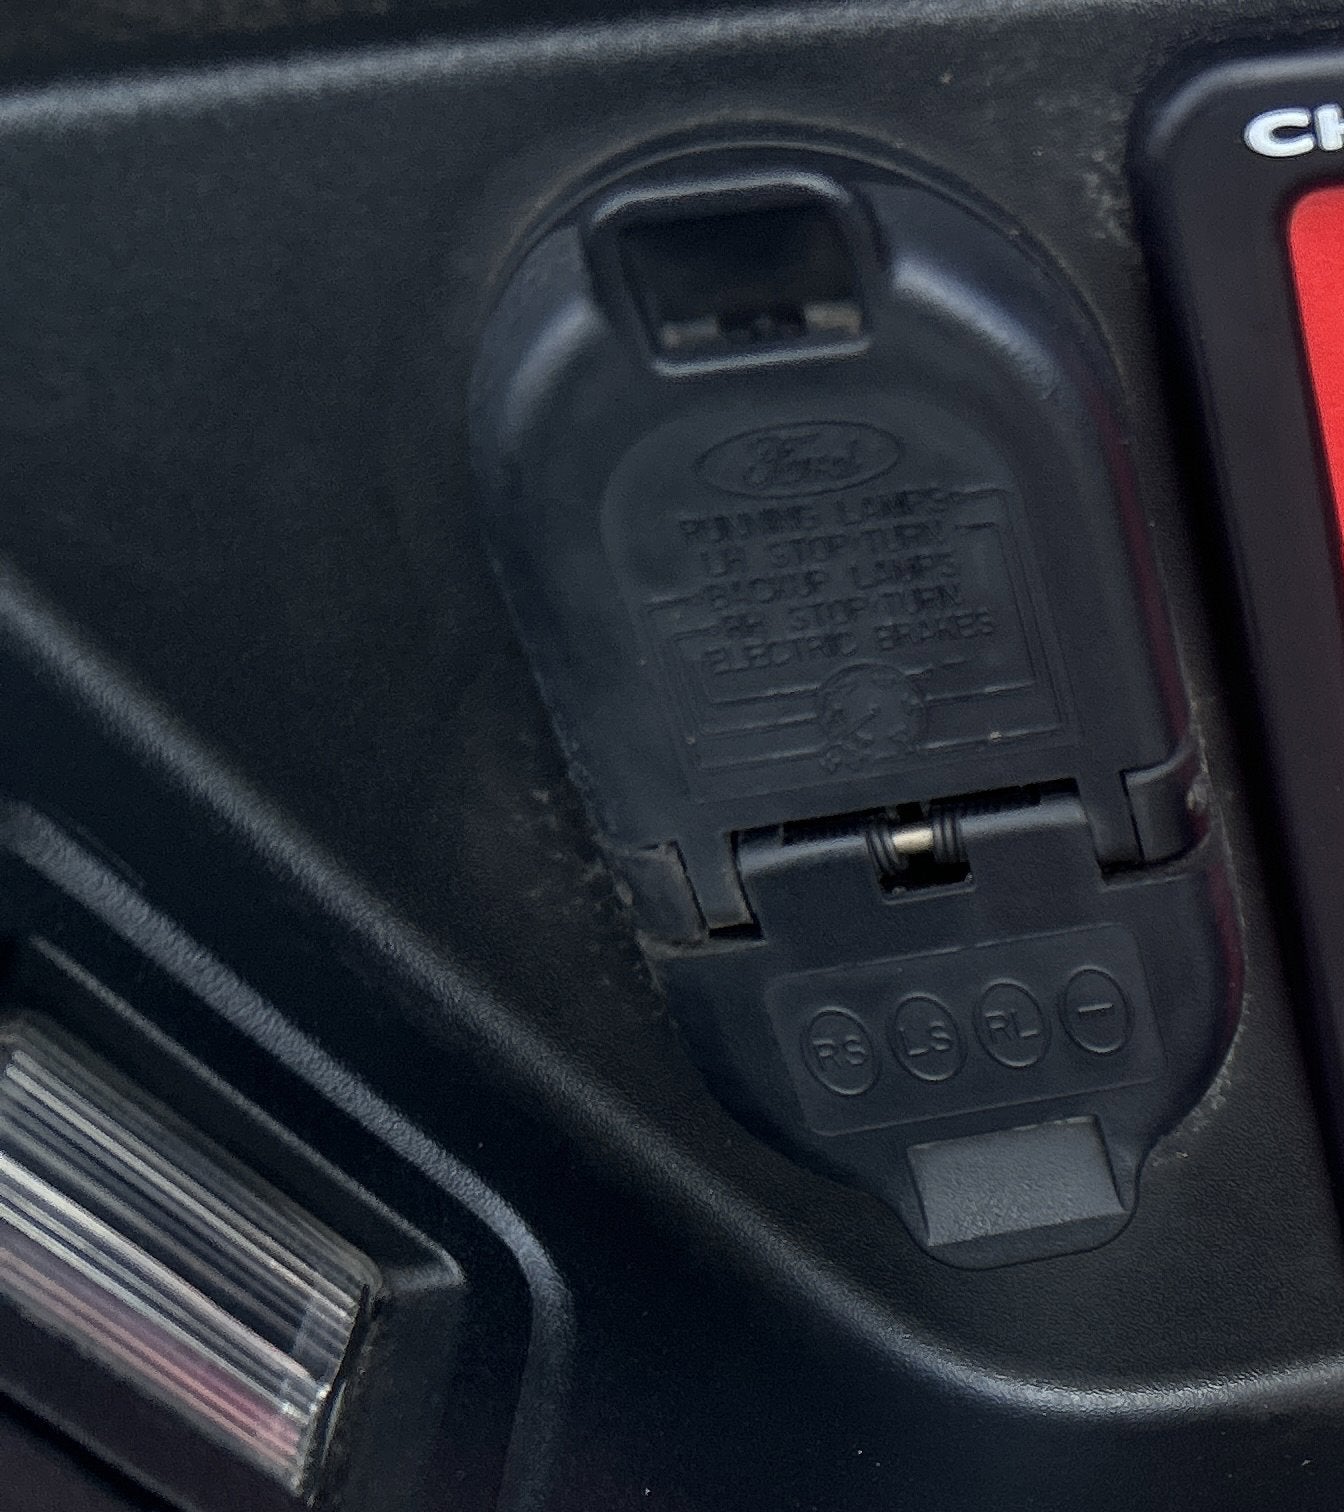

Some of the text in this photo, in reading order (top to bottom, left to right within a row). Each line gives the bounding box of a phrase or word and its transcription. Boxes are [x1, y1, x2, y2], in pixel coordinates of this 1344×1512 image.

[874, 609, 995, 652] BRAKES
[899, 1019, 953, 1057] LS
[984, 1008, 1041, 1045] RL
[811, 1034, 867, 1072] RS
